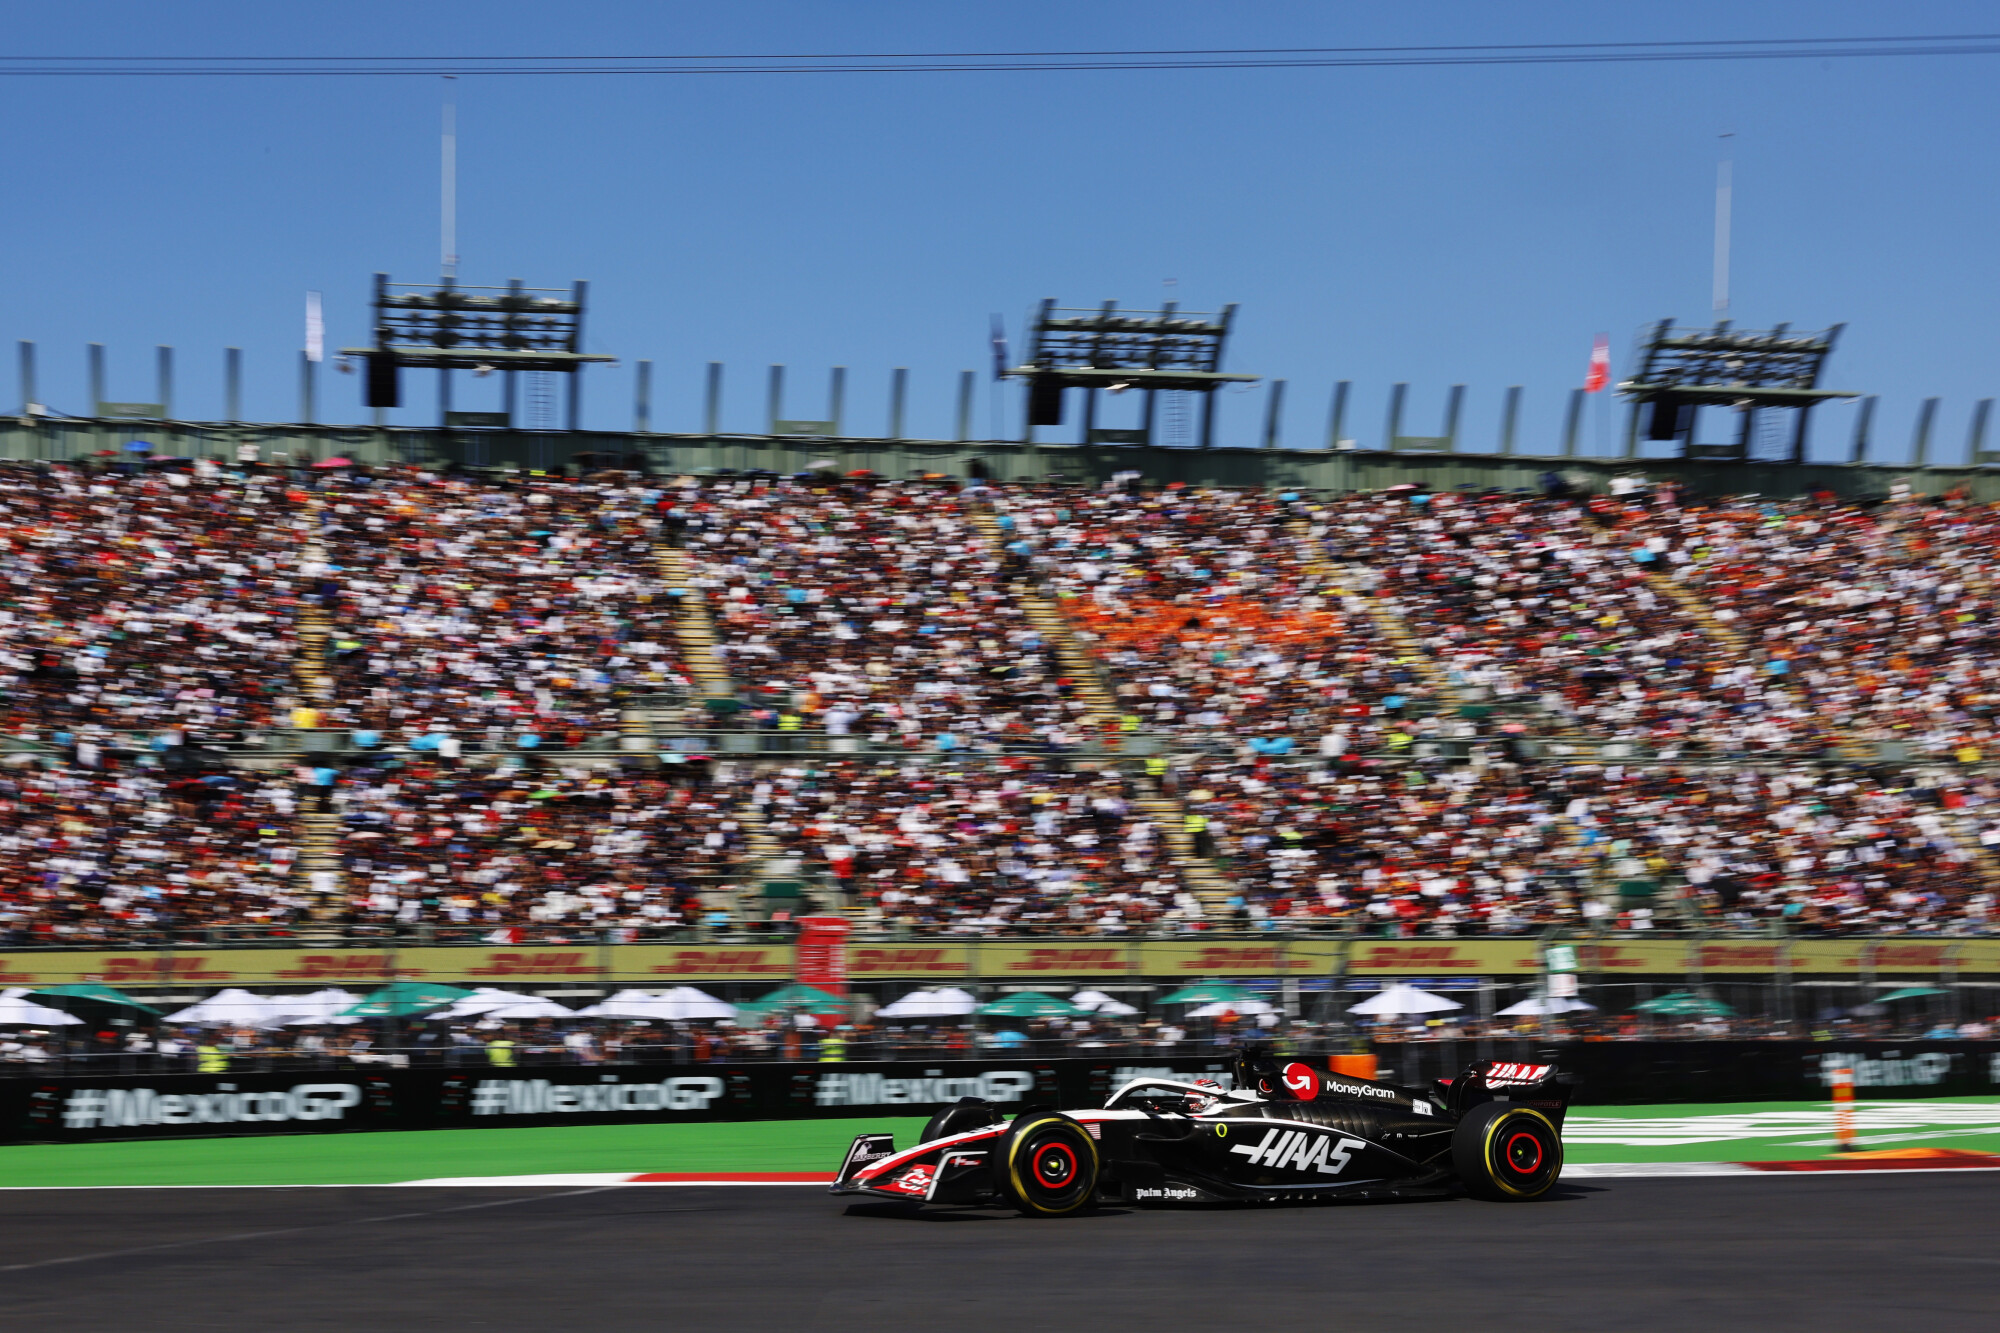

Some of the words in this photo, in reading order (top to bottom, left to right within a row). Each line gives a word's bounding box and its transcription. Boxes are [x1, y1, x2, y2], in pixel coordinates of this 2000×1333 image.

[62, 1081, 361, 1129] #MexicoGP
[471, 1074, 725, 1116] #MexicoGP
[1326, 1080, 1395, 1099] MoneyGram
[1229, 1128, 1366, 1175] HAAS
[1135, 1187, 1162, 1200] Palm
[1163, 1187, 1197, 1200] Angels
